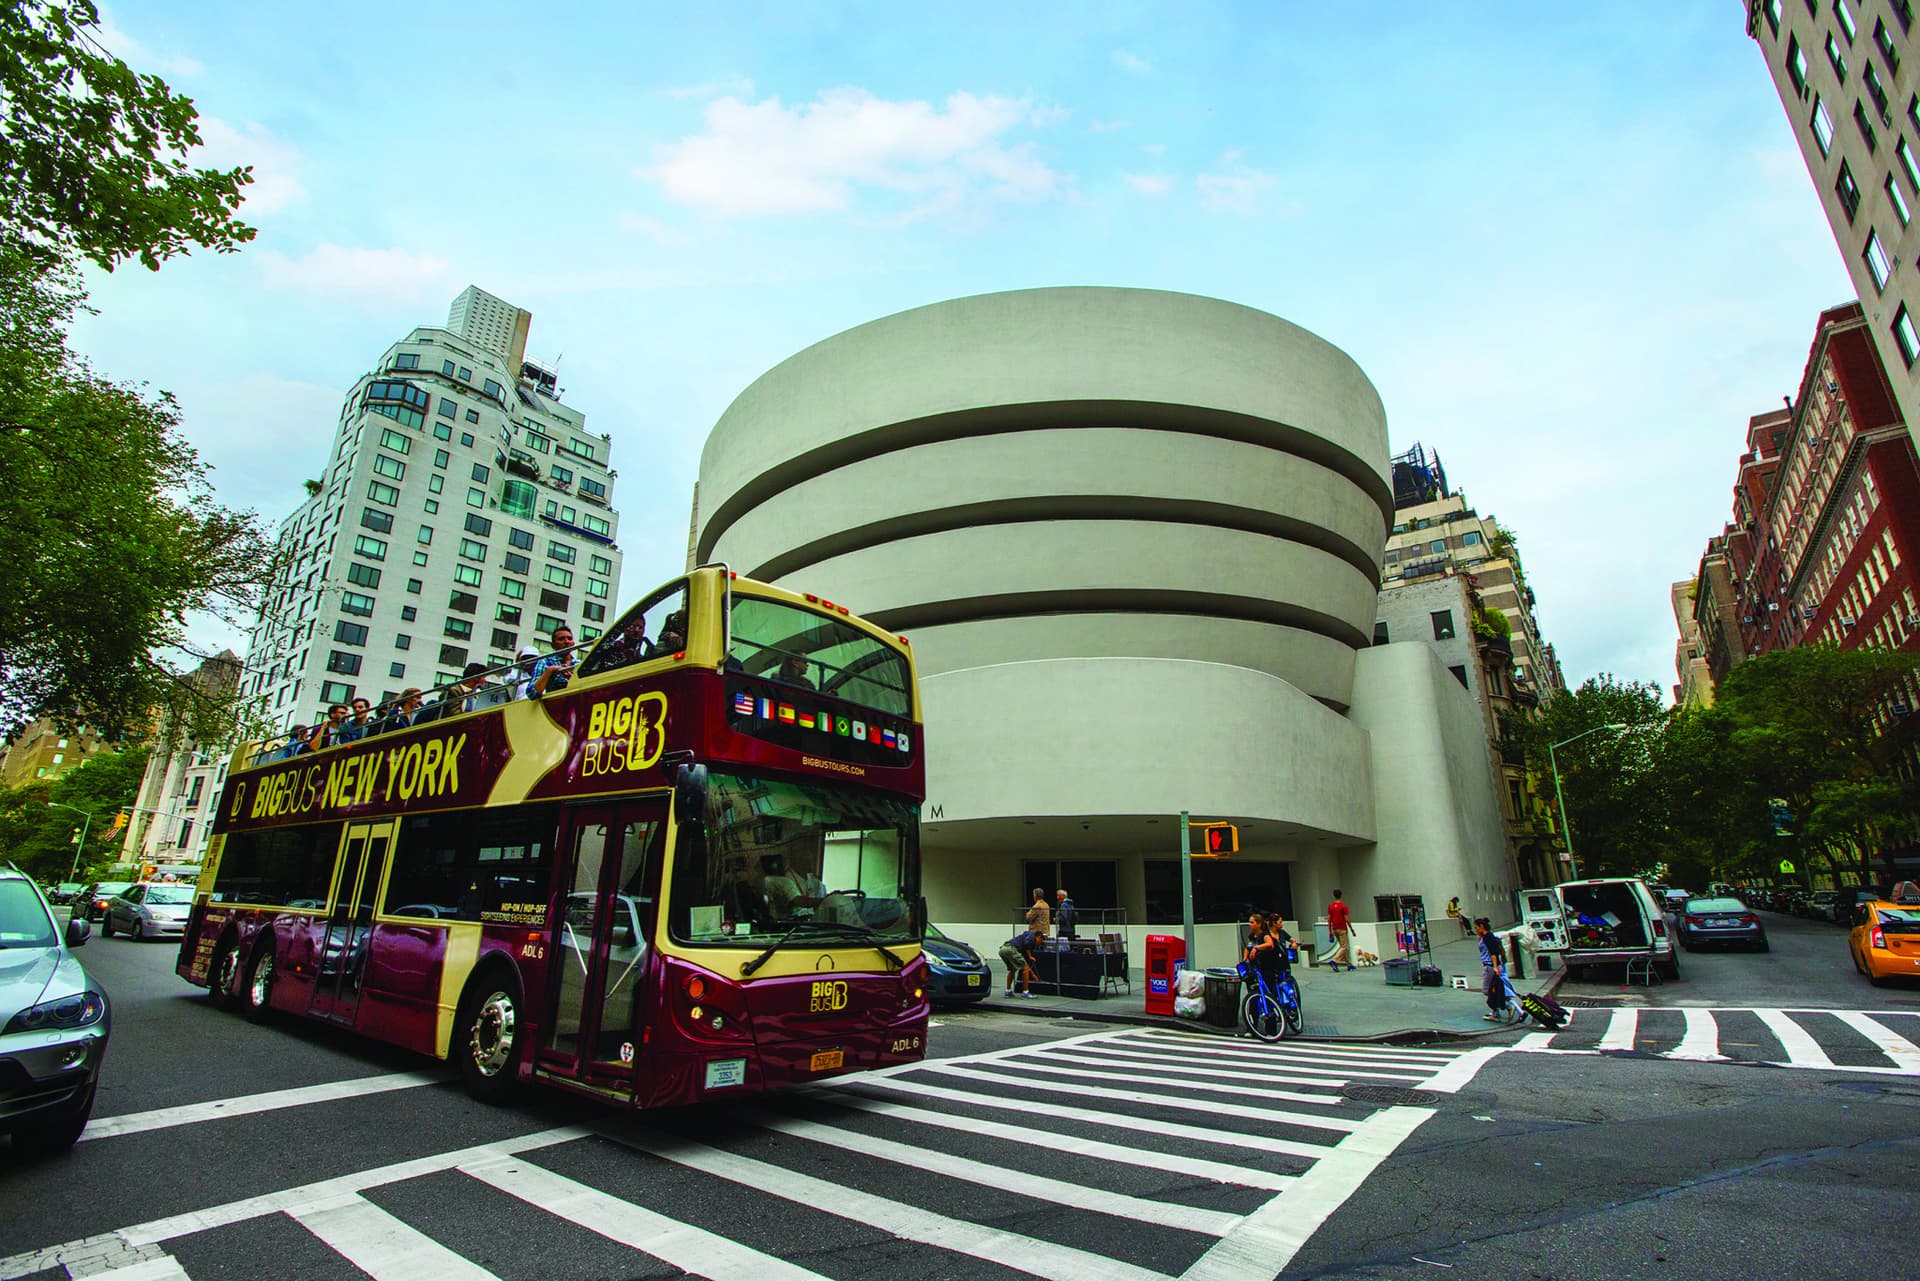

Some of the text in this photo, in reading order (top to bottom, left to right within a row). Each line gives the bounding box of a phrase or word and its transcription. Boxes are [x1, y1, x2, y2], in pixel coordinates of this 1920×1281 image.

[588, 697, 632, 739] BIG
[582, 738, 627, 777] BUS
[321, 750, 384, 810] NEW
[385, 733, 467, 802] YORK
[802, 756, 865, 777] BIGBUSTOURS.COM
[501, 903, 520, 912] HOP-ON
[524, 904, 546, 913] HOP-OFF
[480, 912, 545, 925] SIGHTSEEING EXPERIENCES
[521, 944, 544, 959] ADL 6
[811, 981, 833, 998] BIG
[810, 997, 832, 1012] BUS
[891, 1036, 919, 1053] ADL 6
